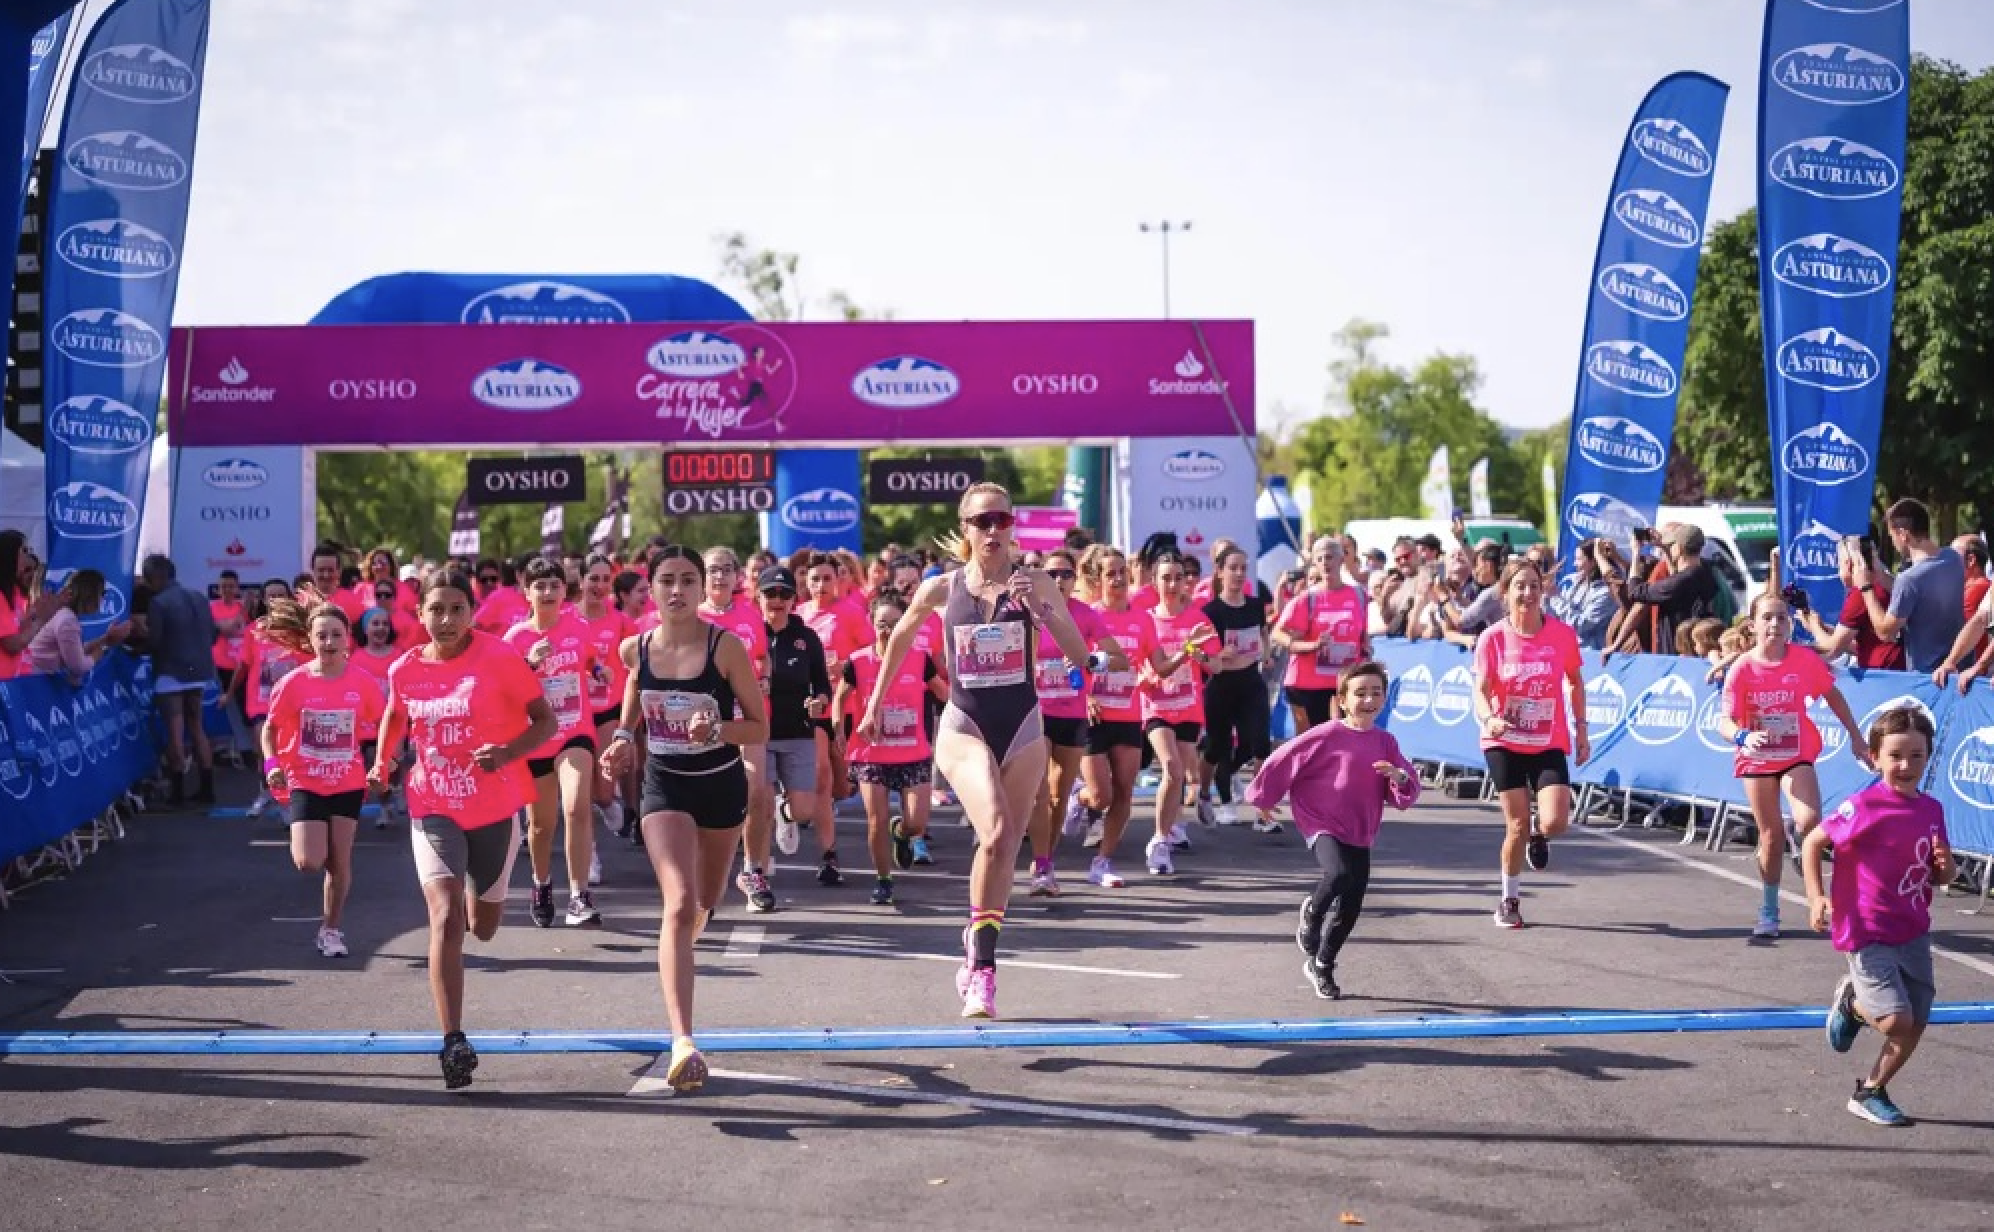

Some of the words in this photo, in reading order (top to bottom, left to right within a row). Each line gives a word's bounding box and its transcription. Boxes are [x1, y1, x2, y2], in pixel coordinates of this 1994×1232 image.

[90, 57, 187, 93] ASTURIANA
[1782, 60, 1893, 91] ASTURIANA
[1637, 127, 1705, 170] ASTURIANA
[75, 147, 177, 180] ASTURIANA
[1780, 153, 1889, 187] ASTURIANA
[1618, 199, 1693, 243] ASTURIANA
[66, 233, 166, 268] ASTURIANA
[1606, 271, 1682, 317] ASTURIANA
[61, 324, 154, 359] ASTURIANA
[655, 349, 738, 365] ASTURIANA
[1592, 350, 1670, 391] ASTURIANA
[1787, 349, 1870, 379] ASTUANA
[191, 385, 277, 402] Santander
[329, 379, 417, 399] OYSHO
[481, 377, 574, 397] ASTURIANA
[636, 374, 720, 400] Carrera
[860, 376, 951, 396] ASTURIANA
[1013, 374, 1099, 395] OYSHO
[56, 413, 142, 443] ATURIANA
[683, 397, 751, 438] Mujer
[1580, 428, 1657, 466] ASTURIANA
[1791, 445, 1857, 474] ASTANA
[208, 471, 264, 483] ASTURIANA
[485, 469, 570, 491] OYSHO
[888, 471, 970, 491] OYSHO
[200, 505, 271, 522] OYSHO
[667, 488, 774, 514] OYSHO
[1159, 496, 1228, 511] OYSHO
[55, 505, 128, 528] URIANA
